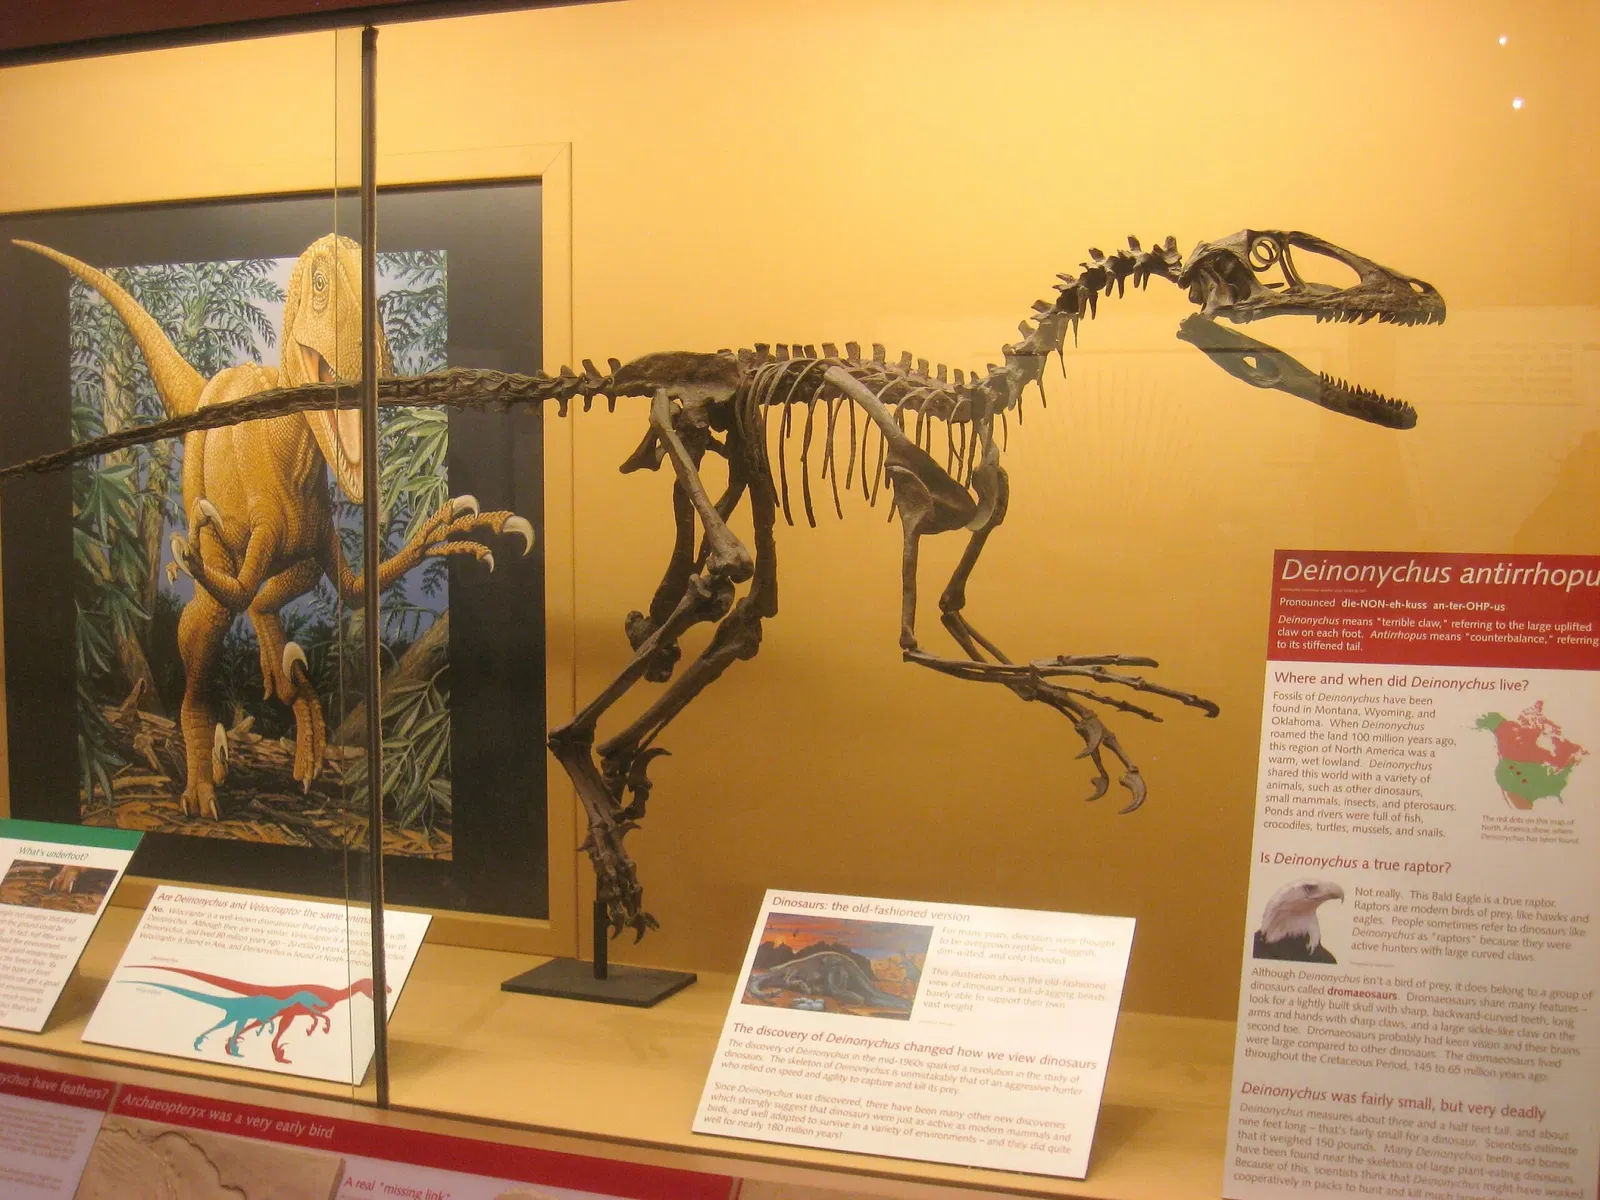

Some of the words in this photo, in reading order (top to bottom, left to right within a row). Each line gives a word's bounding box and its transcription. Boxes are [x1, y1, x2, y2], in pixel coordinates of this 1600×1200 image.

[1281, 559, 1452, 586] Deinonychus
[1279, 597, 1335, 607] Pronounced
[1341, 599, 1427, 609] die-NON-eh-kuss
[1433, 601, 1505, 611] an-ter-OHP-us
[1278, 615, 1339, 629] Deinonychus
[1342, 618, 1373, 626] means
[1377, 617, 1415, 627] "terrible
[1418, 618, 1447, 628] claw,"
[1451, 619, 1492, 631] referring
[1495, 620, 1506, 629] to
[1508, 620, 1524, 630] the
[1527, 621, 1551, 632] large
[1554, 622, 1592, 633] uplifted
[1276, 640, 1286, 648] to
[1289, 640, 1300, 649] its
[1302, 640, 1343, 650] stiffened
[1346, 641, 1362, 650] tail.
[1277, 627, 1299, 636] claw
[1301, 629, 1313, 637] on
[1316, 628, 1338, 637] each
[1341, 628, 1363, 638] foot.
[1369, 630, 1427, 641] Antirrhopus
[1429, 633, 1461, 641] means
[1465, 633, 1553, 644] "counterbalance,"
[1557, 634, 1599, 647] referring
[1275, 672, 1316, 684] Where
[1320, 673, 1344, 685] and
[1347, 674, 1383, 686] when
[1387, 675, 1407, 687] did
[1411, 676, 1496, 691] Deinonychus
[1500, 678, 1529, 691] live?
[1273, 691, 1302, 700] Fossils
[1304, 691, 1315, 700] of
[1317, 692, 1380, 704] Deinonychus
[1382, 694, 1406, 704] have
[1409, 695, 1433, 705] been
[1272, 703, 1300, 713] found
[1303, 705, 1311, 713] in
[1314, 705, 1360, 716] Montana,
[1364, 707, 1414, 720] Wyoming,
[1417, 709, 1436, 718] and
[1271, 716, 1323, 727] Oklahoma.
[1329, 718, 1359, 728] When
[1361, 720, 1424, 731] Deinonychus
[1270, 730, 1306, 739] roamed
[1309, 730, 1324, 740] the
[1327, 731, 1348, 740] land
[1352, 732, 1370, 742] 100
[1372, 733, 1404, 743] million
[1407, 736, 1433, 746] years
[1435, 737, 1456, 747] ago,
[1269, 741, 1286, 751] this
[1288, 744, 1318, 754] region
[1321, 743, 1332, 753] of
[1334, 744, 1362, 754] North
[1365, 746, 1404, 756] America
[1407, 749, 1427, 757] was
[1429, 750, 1436, 758] a
[1268, 756, 1298, 767] warm,
[1301, 757, 1319, 765] wet
[1321, 756, 1361, 767] lowland.
[1368, 759, 1432, 771] Deinonychus
[1267, 767, 1299, 777] shared
[1301, 768, 1318, 778] this
[1321, 770, 1348, 779] world
[1351, 771, 1372, 780] with
[1384, 774, 1417, 785] variety
[1419, 774, 1431, 783] of
[1266, 781, 1304, 792] animals,
[1308, 782, 1329, 792] such
[1345, 784, 1372, 794] other
[1374, 785, 1423, 797] dinosaurs,
[1265, 793, 1289, 803] small
[1292, 796, 1340, 806] mammals,
[1344, 798, 1378, 808] insects,
[1382, 799, 1400, 808] and
[1403, 801, 1456, 811] pterosaurs.
[1264, 806, 1293, 816] Ponds
[1296, 808, 1314, 817] and
[1317, 809, 1343, 819] rivers
[1345, 812, 1369, 820] were
[1372, 811, 1388, 821] full
[1390, 812, 1401, 822] of
[1404, 813, 1423, 824] fish,
[1263, 820, 1312, 831] crocodiles,
[1316, 822, 1348, 833] turtles,
[1352, 825, 1392, 835] mussels,
[1395, 826, 1414, 836] and
[1416, 827, 1446, 837] snails.
[1260, 851, 1270, 863] Is
[1274, 852, 1358, 869] Deinonychus
[1361, 860, 1369, 869] a
[1374, 858, 1400, 871] true
[1404, 861, 1451, 875] raptor?
[772, 896, 828, 909] Dinosaurs:
[831, 901, 849, 912] the
[851, 904, 928, 918] old-fashioned
[931, 912, 970, 921] version
[1250, 980, 1295, 992] dinosaurs
[1297, 984, 1324, 994] called
[734, 1022, 753, 1034] The
[756, 1025, 808, 1042] discovery
[810, 1031, 824, 1041] of
[825, 1033, 900, 1049] Deinonychus
[903, 1041, 954, 1056] changed
[956, 1046, 983, 1058] how
[987, 1051, 1004, 1060] we
[1008, 1052, 1036, 1063] view
[1039, 1055, 1097, 1069] dinosaurs
[32, 1075, 58, 1091] have
[59, 1080, 109, 1100] feathers?
[1241, 1082, 1327, 1100] Deinonychus
[1331, 1092, 1356, 1103] was
[1361, 1091, 1394, 1109] fairly
[1440, 1098, 1463, 1112] but
[1467, 1104, 1496, 1118] very
[1500, 1104, 1546, 1122] deadly
[122, 1093, 205, 1118] Archaeopteryx
[209, 1110, 232, 1122] was
[234, 1114, 242, 1124] a
[246, 1116, 272, 1131] very
[275, 1121, 305, 1136] early
[308, 1123, 334, 1138] bird
